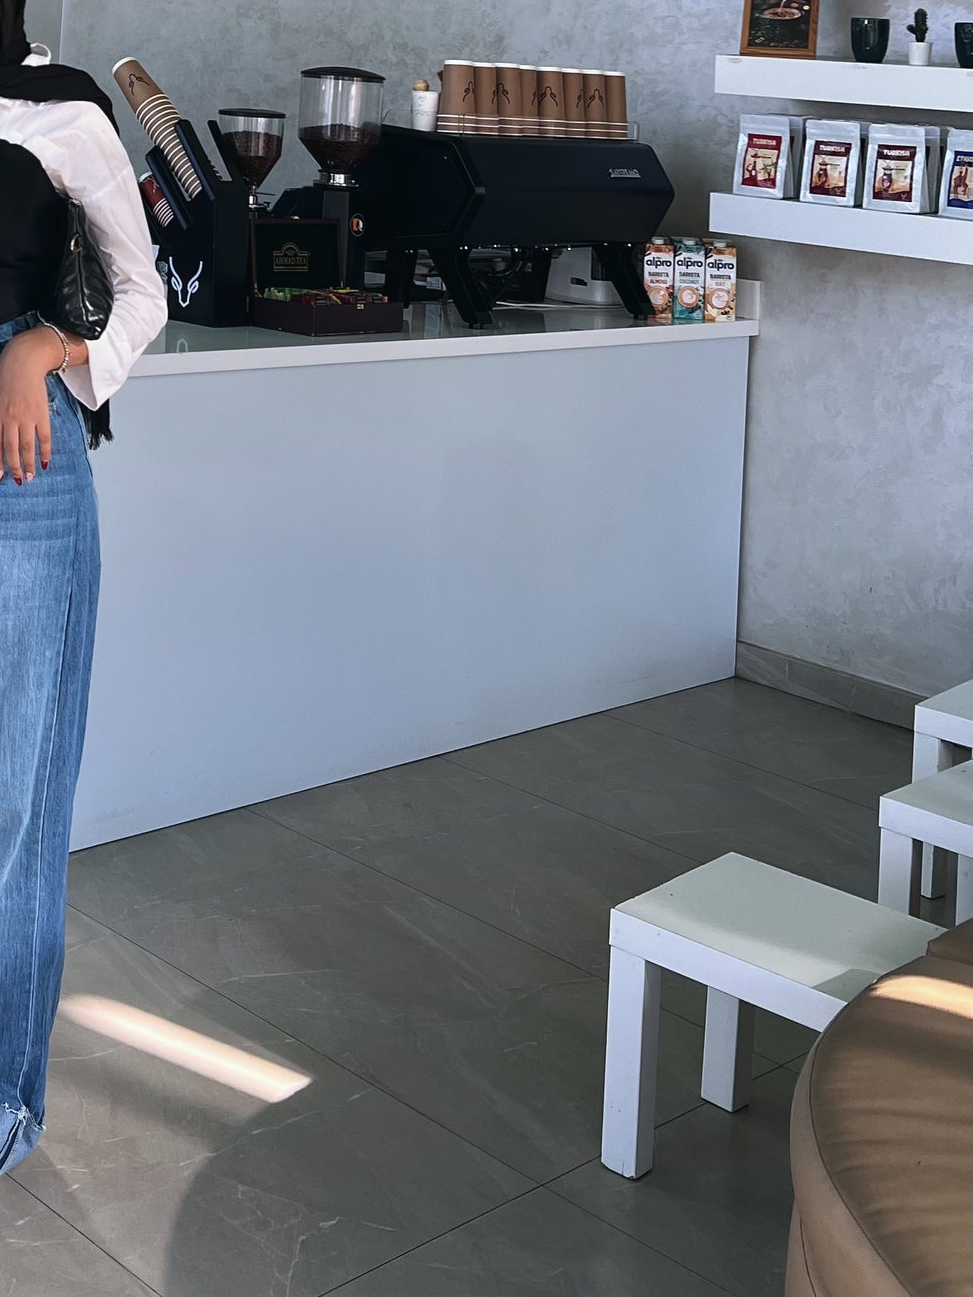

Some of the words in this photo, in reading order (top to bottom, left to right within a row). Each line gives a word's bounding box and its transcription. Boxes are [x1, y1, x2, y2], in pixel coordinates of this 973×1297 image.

[646, 256, 672, 269] alpro
[677, 256, 703, 269] alpro
[707, 259, 735, 271] alpro
